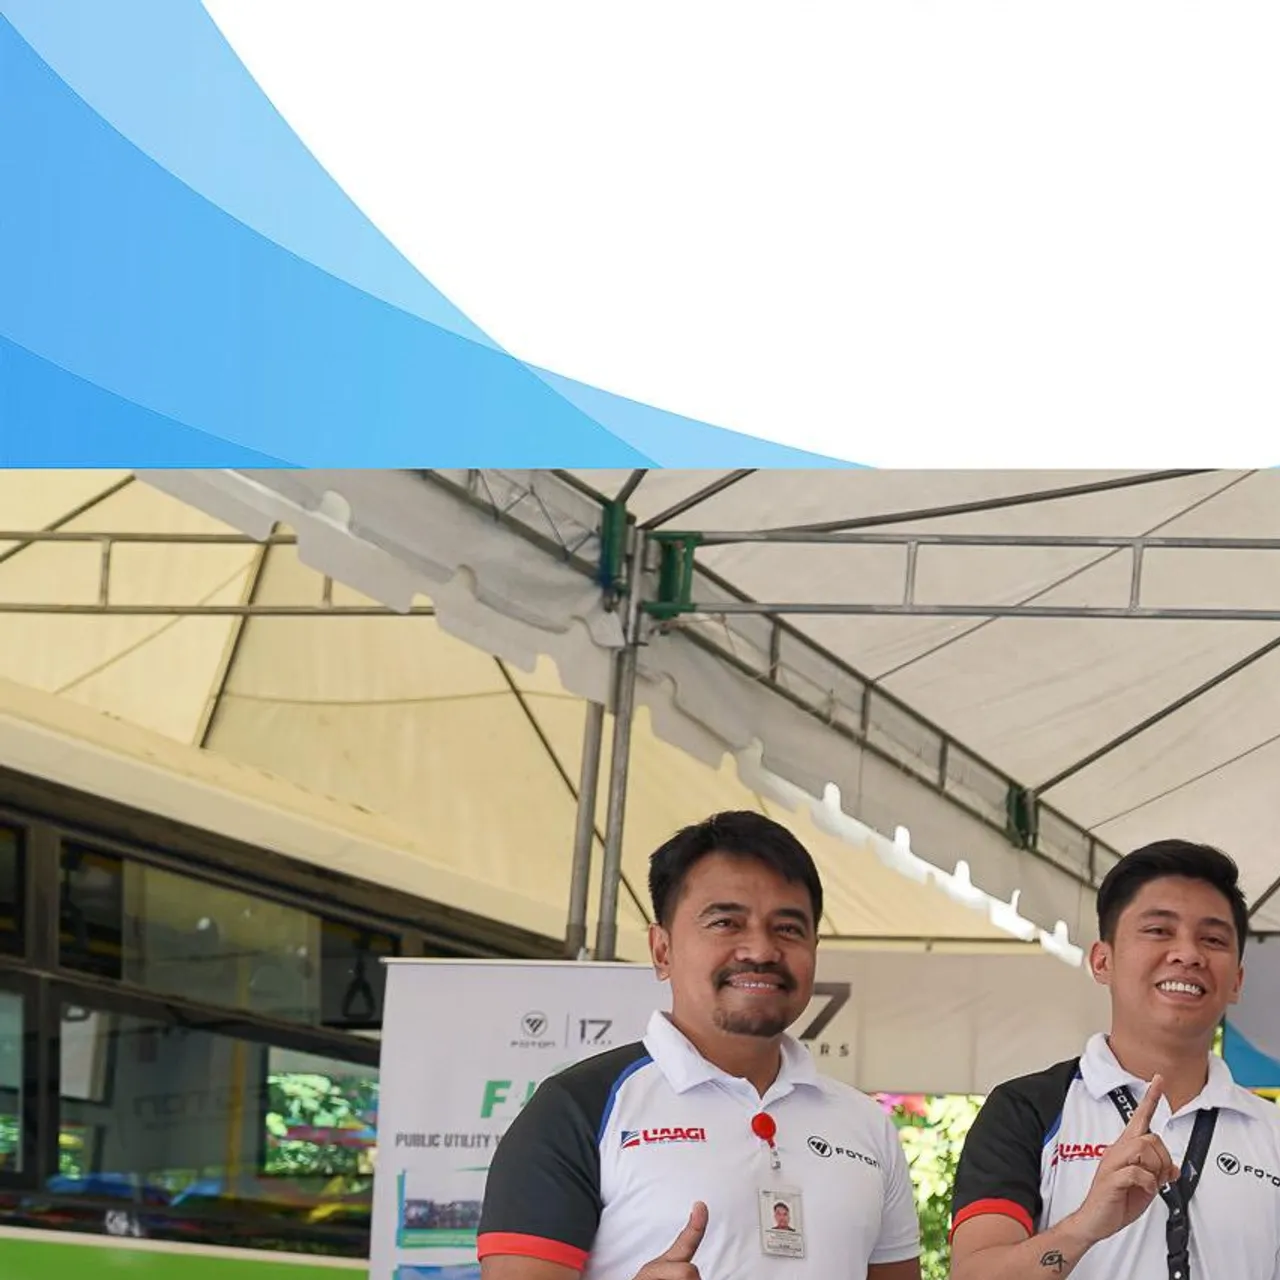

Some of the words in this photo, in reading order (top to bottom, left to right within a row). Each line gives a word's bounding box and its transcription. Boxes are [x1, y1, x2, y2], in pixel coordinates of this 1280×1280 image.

[579, 1020, 612, 1041] 17
[395, 1133, 440, 1147] PUBLIC
[444, 1133, 490, 1148] UTILITY
